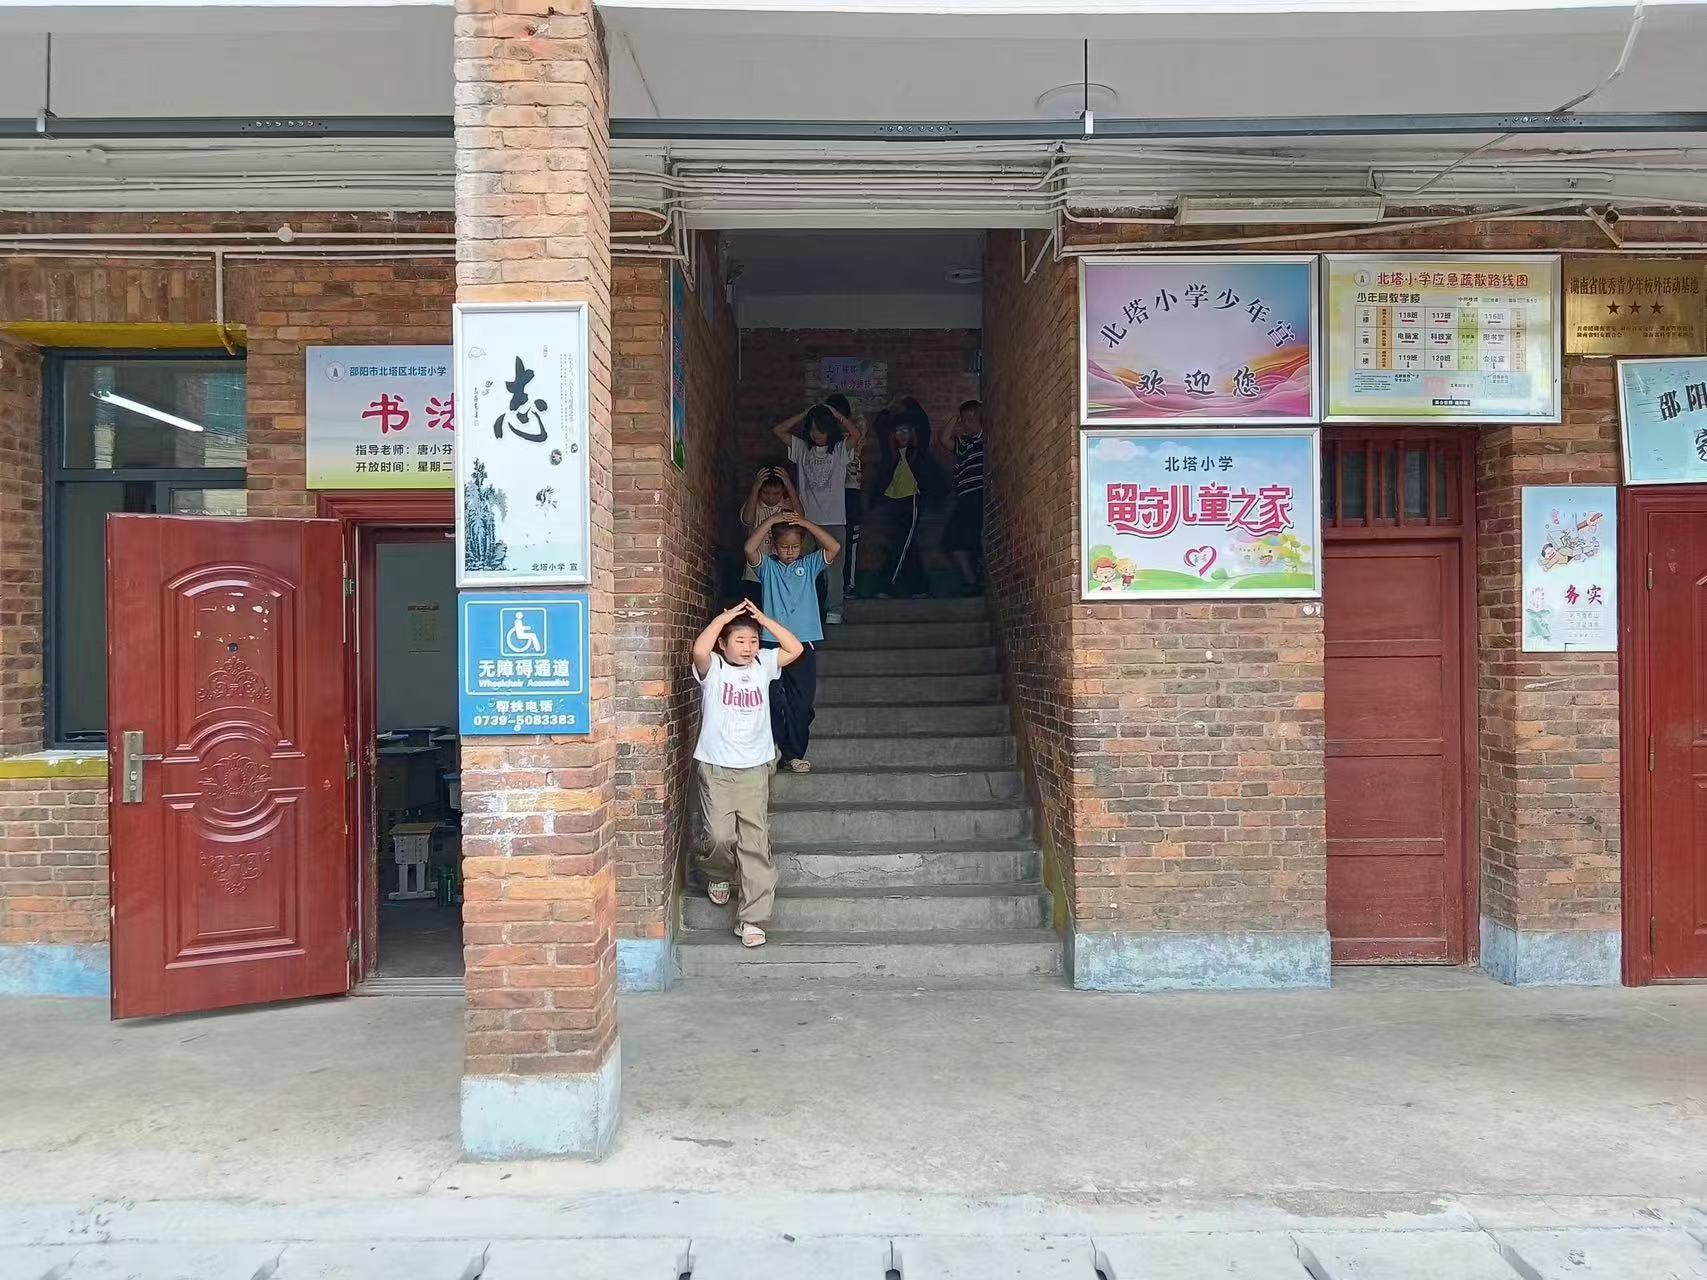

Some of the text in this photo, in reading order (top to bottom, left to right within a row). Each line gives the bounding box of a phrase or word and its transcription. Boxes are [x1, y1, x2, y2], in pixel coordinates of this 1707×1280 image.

[1377, 271, 1529, 288] 北塔小学应急疏散路线图
[1356, 292, 1421, 304] 少年宫教学楼
[1100, 282, 1297, 349] 北塔小学少年宫
[1399, 311, 1418, 319] 118班
[350, 366, 447, 377] 邵阳市北塔区北塔小学
[1136, 366, 1261, 398] 欢迎您
[493, 355, 548, 443] 志
[1164, 456, 1233, 473] 北塔小学
[1106, 481, 1293, 537] 留守儿童之家
[531, 562, 566, 572] 北塔小学
[1564, 584, 1603, 606] 务实
[478, 659, 570, 678] 无障碍通道
[473, 714, 576, 727] 0739-5083383
